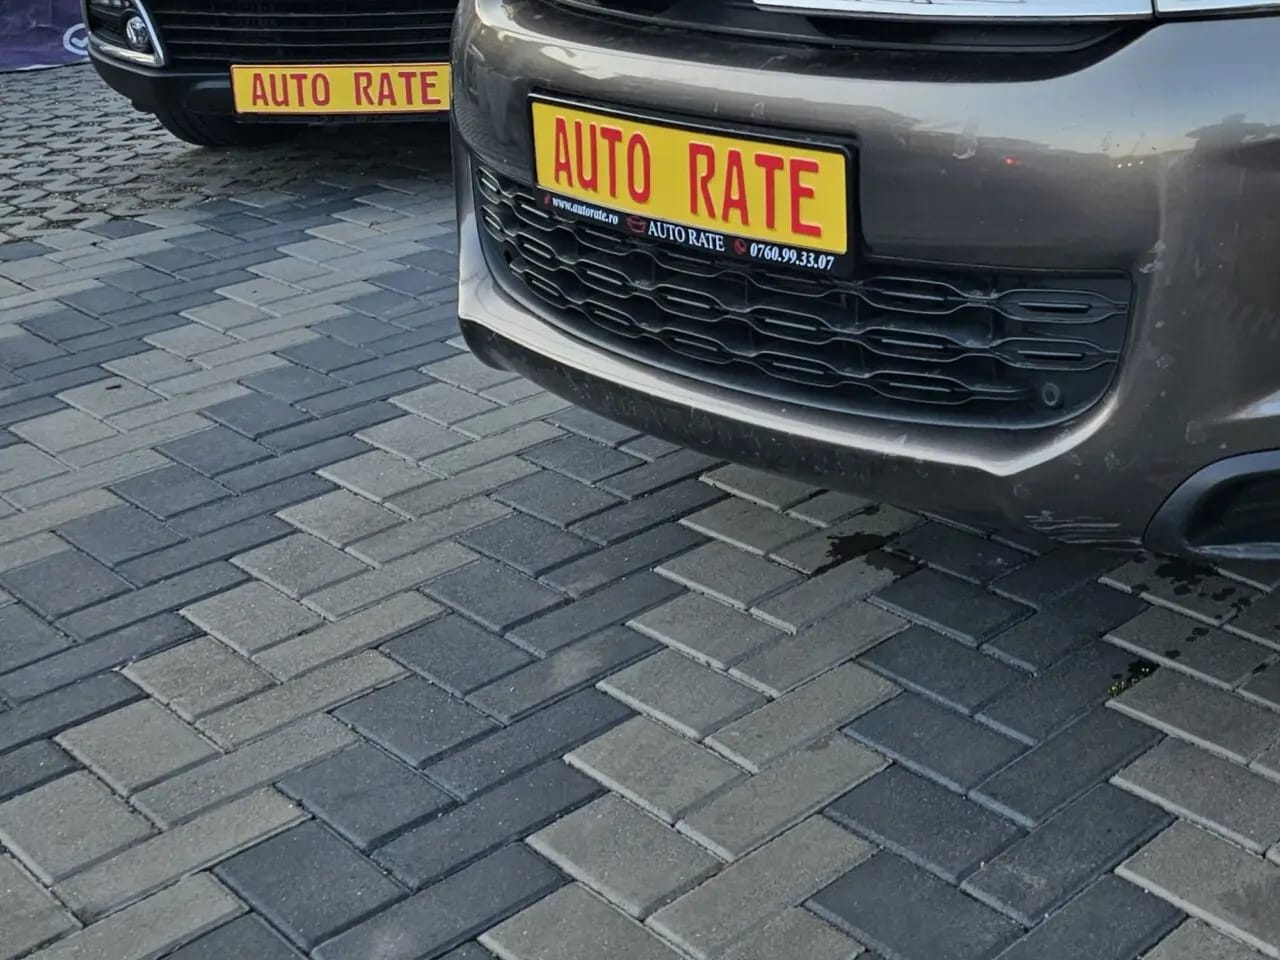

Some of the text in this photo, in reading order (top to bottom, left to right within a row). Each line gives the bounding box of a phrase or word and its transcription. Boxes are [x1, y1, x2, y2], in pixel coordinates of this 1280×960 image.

[252, 70, 441, 108] AUTO RATE
[554, 116, 822, 238] AUTO RATE
[551, 196, 619, 225] www.autorate.ro
[647, 221, 725, 252] AUTO RATE
[749, 242, 835, 271] 0760.99.33.07
